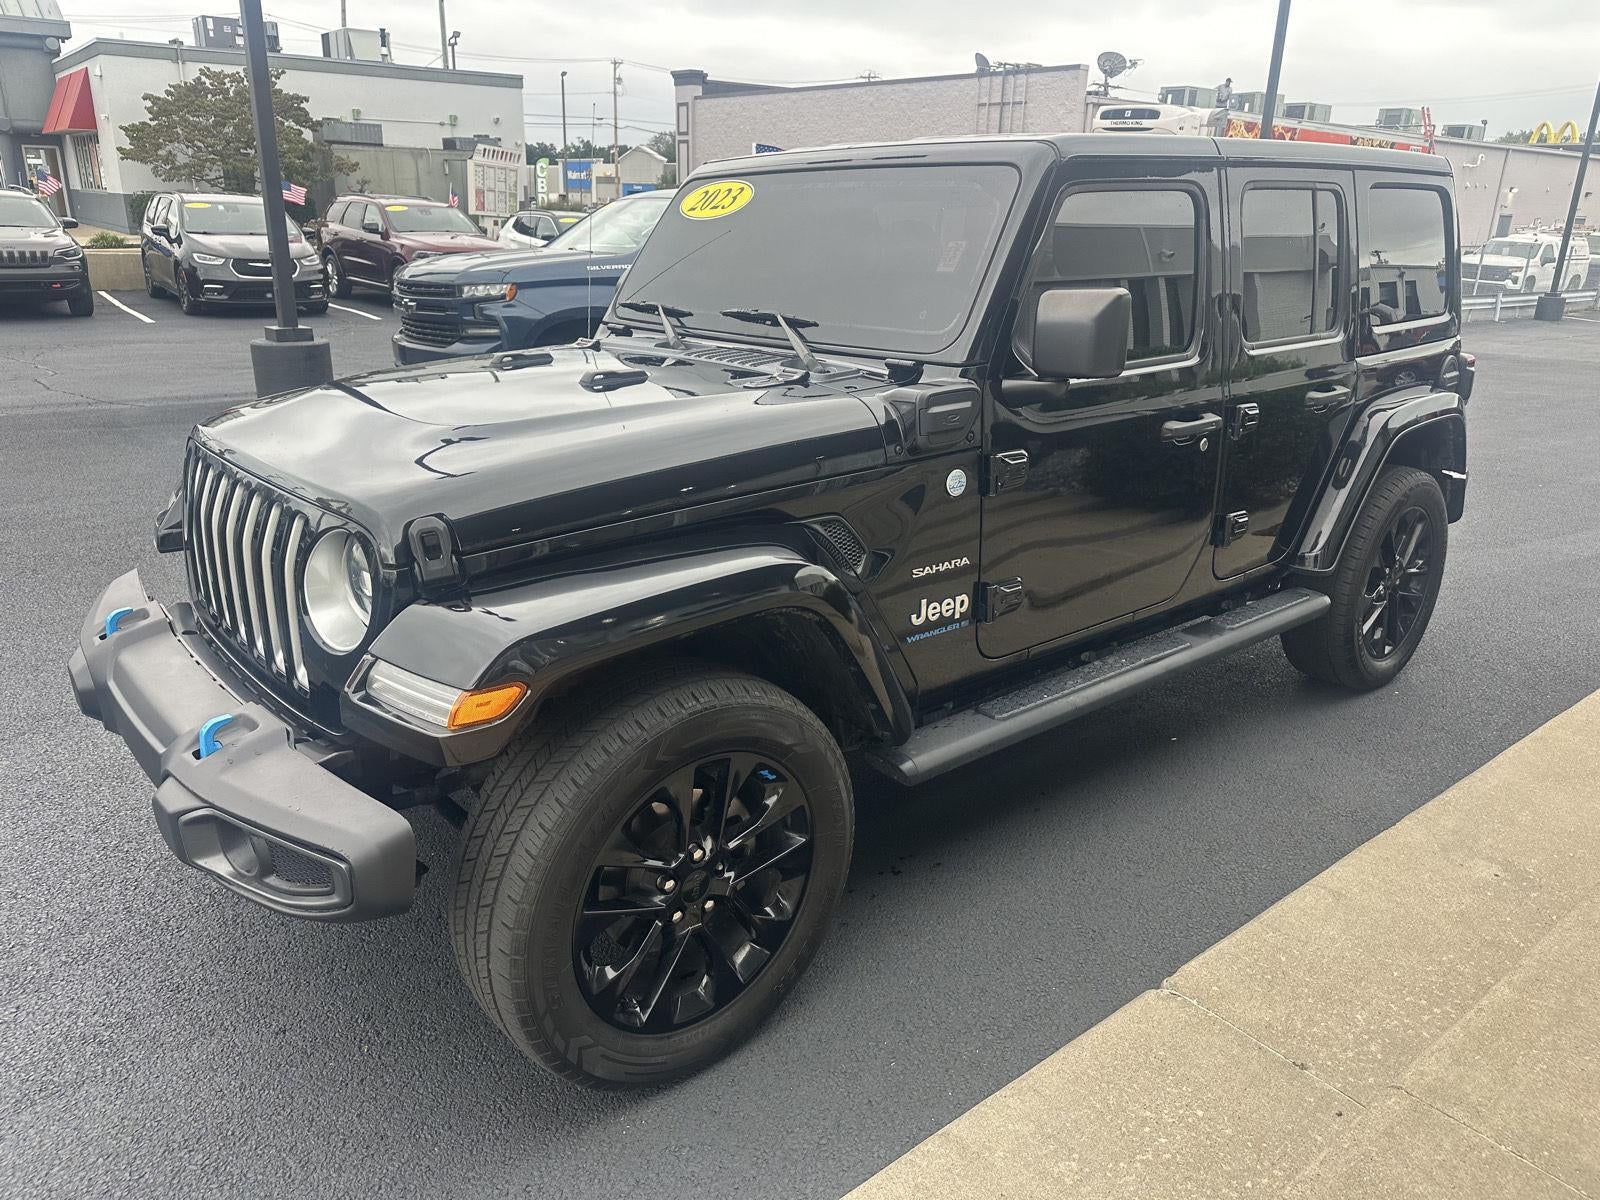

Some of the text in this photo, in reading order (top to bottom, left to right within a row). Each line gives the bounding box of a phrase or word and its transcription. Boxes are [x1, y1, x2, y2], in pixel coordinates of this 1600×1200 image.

[536, 162, 548, 206] CBD
[687, 186, 745, 212] 2023
[586, 263, 633, 271] SILVERAD
[911, 556, 971, 579] SAHARA
[910, 593, 970, 626] Jeep
[905, 622, 960, 644] WRANGLER
